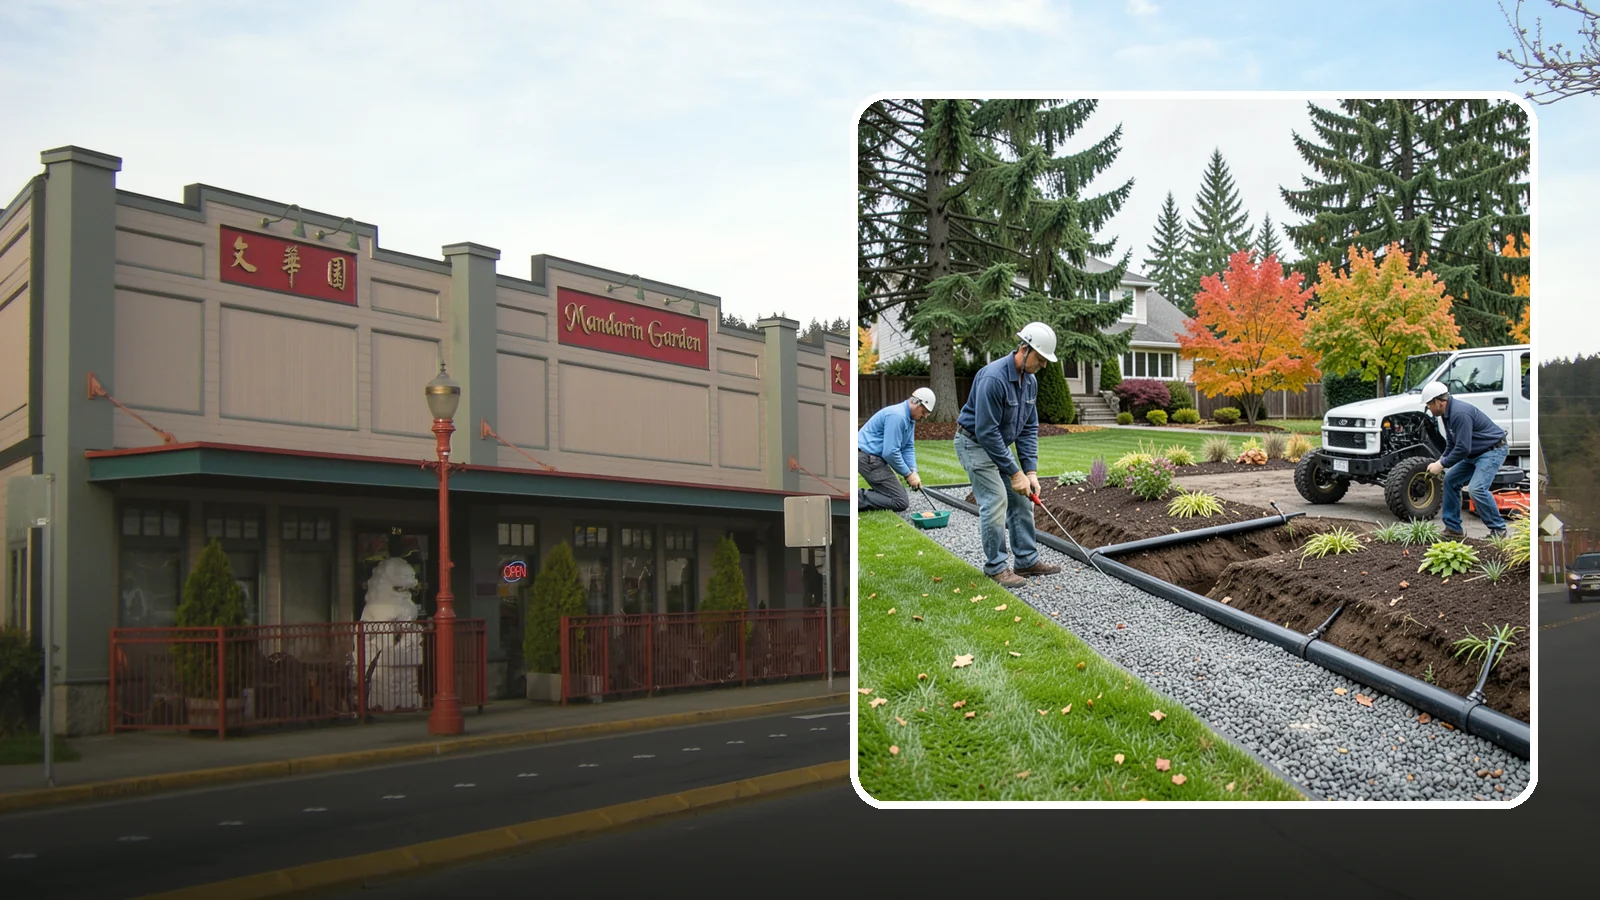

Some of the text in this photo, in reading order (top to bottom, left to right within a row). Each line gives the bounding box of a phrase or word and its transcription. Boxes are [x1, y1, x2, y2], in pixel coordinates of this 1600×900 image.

[231, 235, 346, 291] 文華園
[564, 302, 702, 352] Mandarin Garden
[503, 565, 527, 578] OPEN
